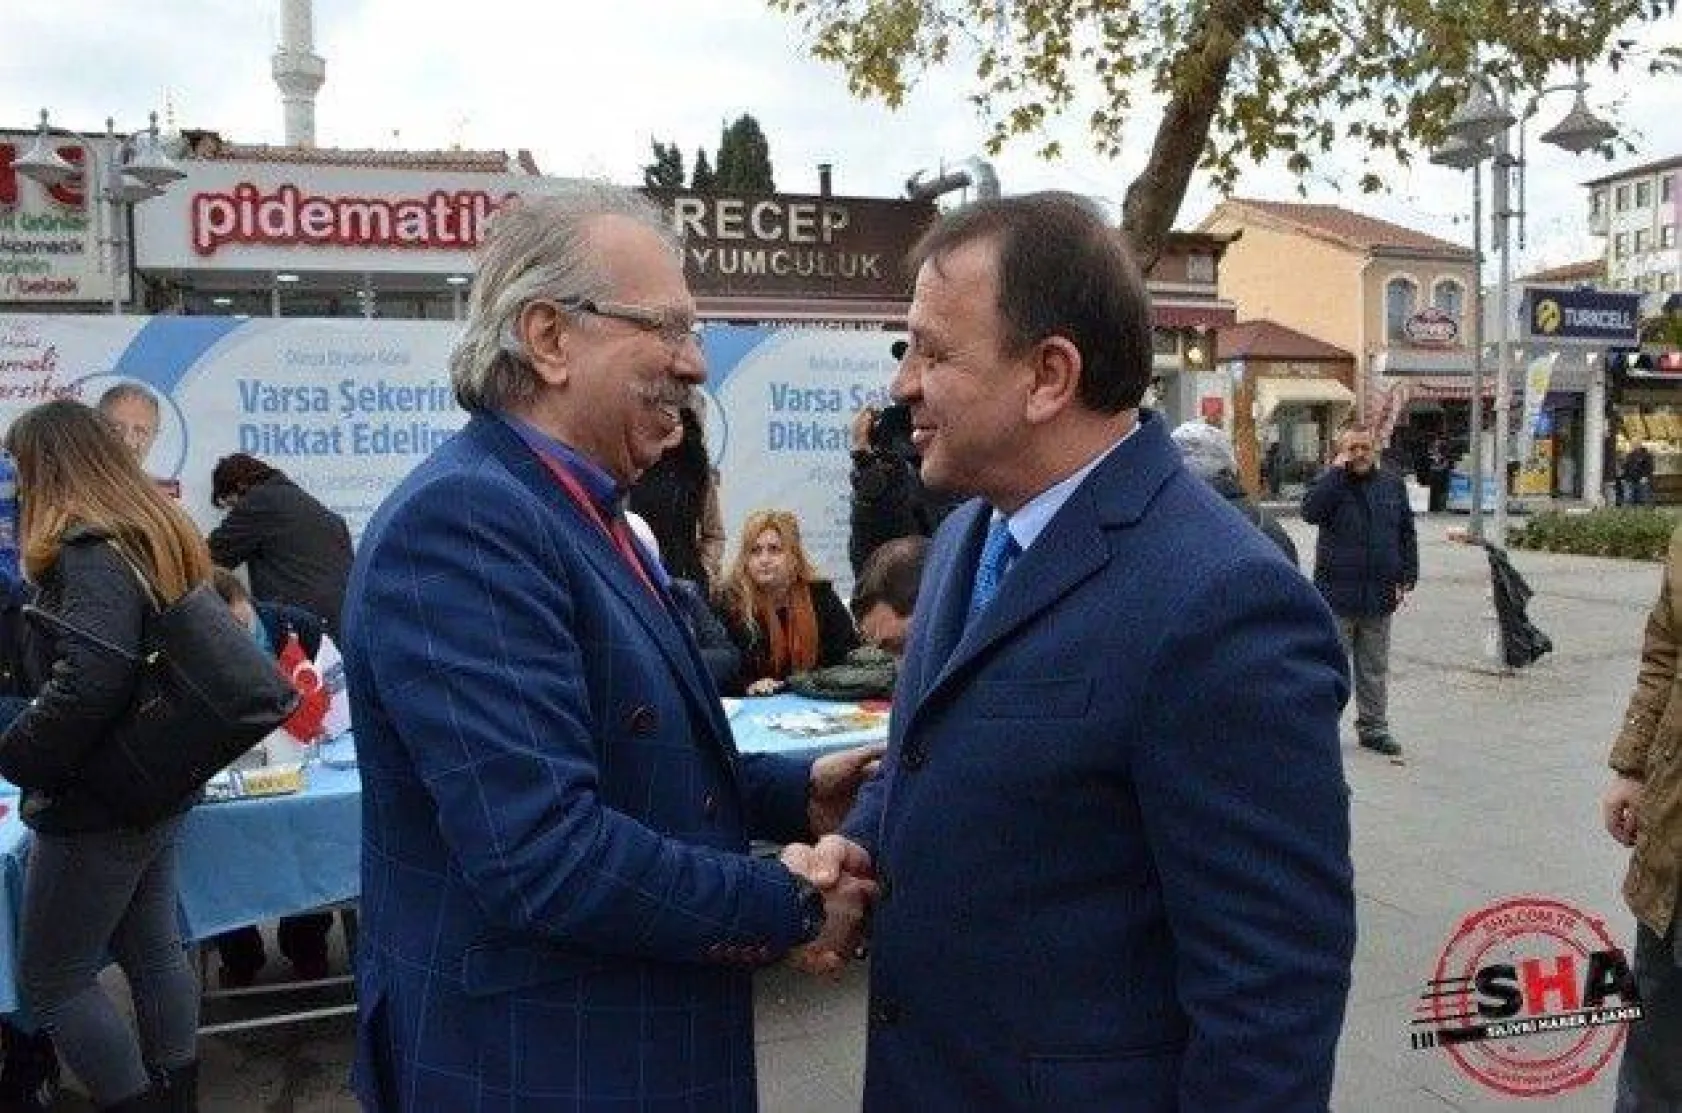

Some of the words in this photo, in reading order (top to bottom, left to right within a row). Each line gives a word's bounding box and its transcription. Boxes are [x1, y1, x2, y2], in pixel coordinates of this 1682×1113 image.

[674, 198, 849, 243] RECEP
[1564, 307, 1633, 330] TURKCELL
[238, 379, 329, 412] Varsa
[770, 382, 841, 412] Varsa
[239, 421, 343, 455] Dikkat
[769, 421, 851, 451] Dikkat
